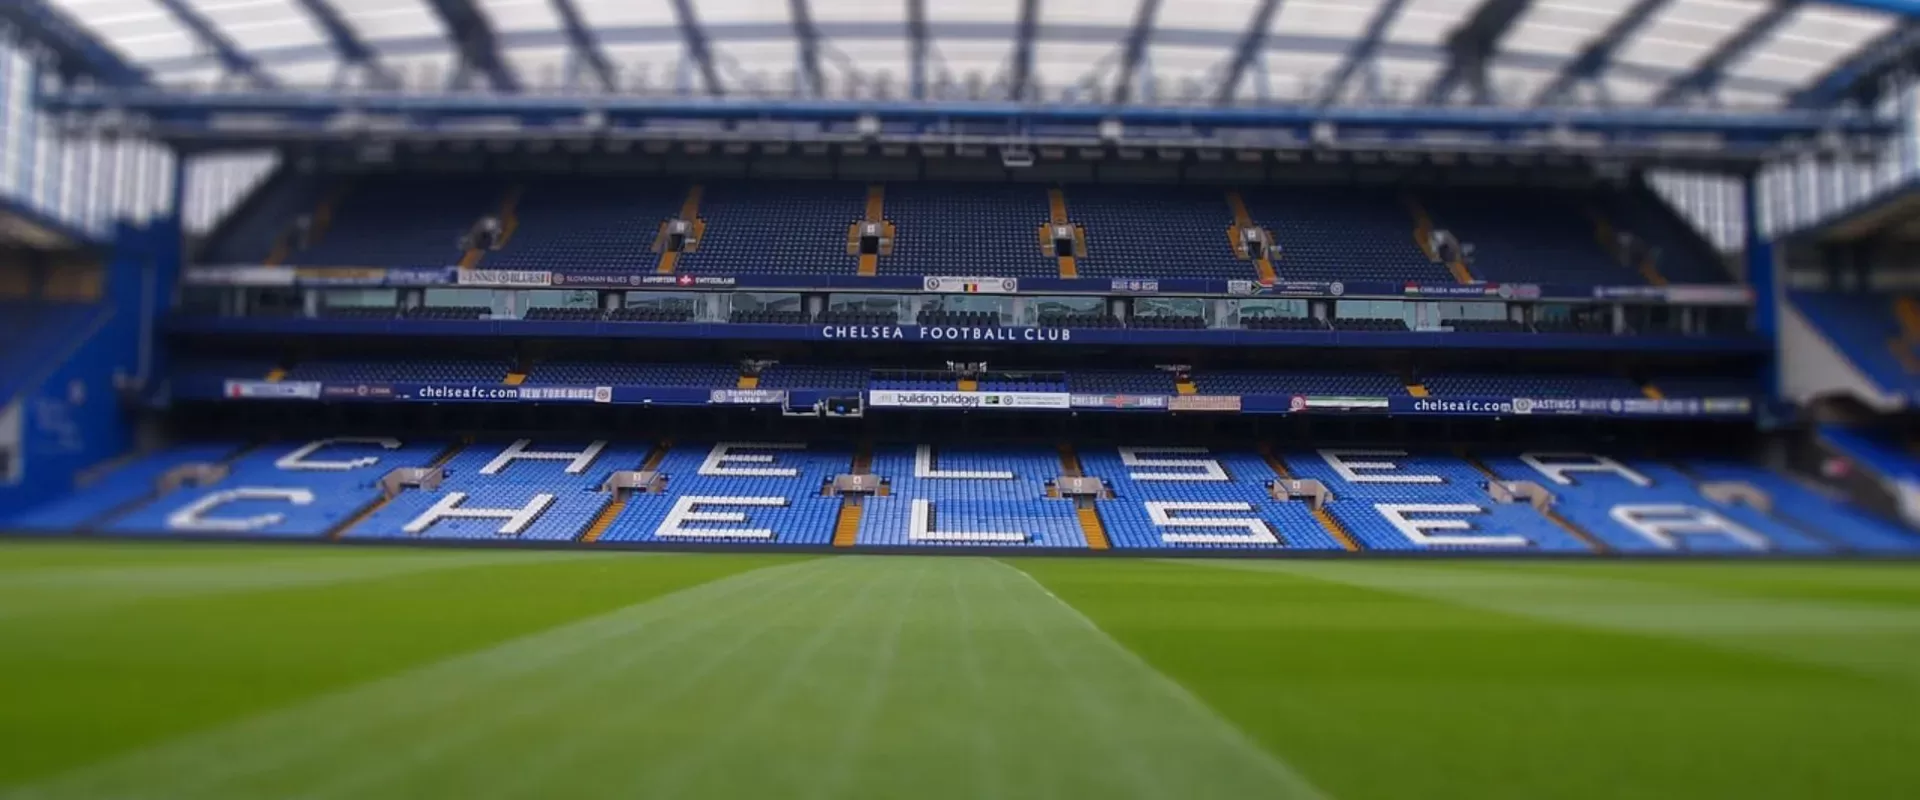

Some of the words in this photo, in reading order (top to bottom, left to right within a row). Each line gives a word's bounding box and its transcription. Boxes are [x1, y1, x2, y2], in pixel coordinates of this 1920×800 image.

[822, 325, 903, 339] CHELSEA
[920, 327, 1016, 340] FOOTBALL
[1024, 328, 1071, 341] CLUB
[419, 386, 517, 398] chelseafc.com
[897, 393, 938, 405] building
[941, 393, 980, 408] bridges
[275, 437, 1653, 488] CHELSEA
[167, 492, 1771, 549] CHELSEA
